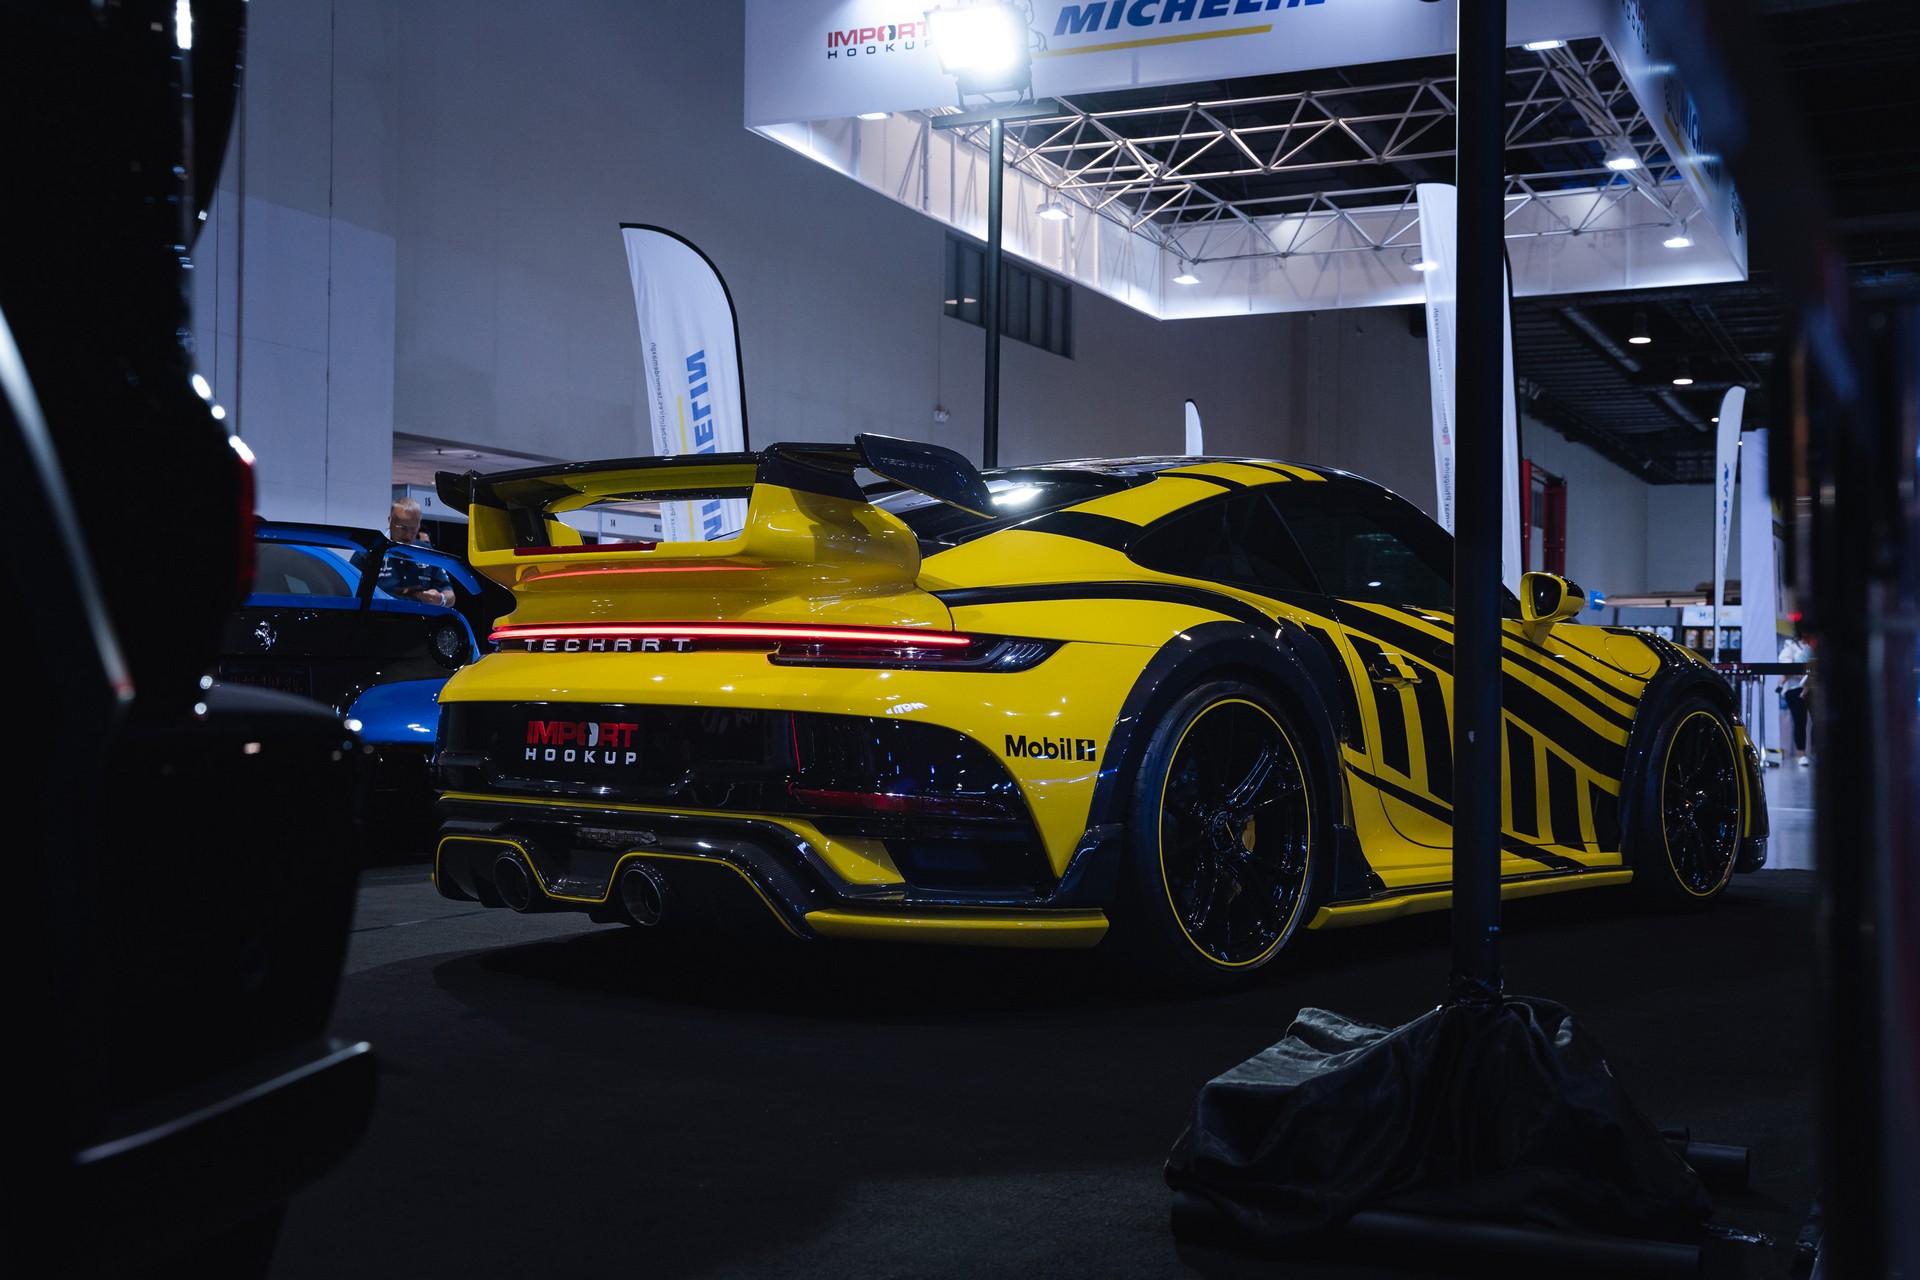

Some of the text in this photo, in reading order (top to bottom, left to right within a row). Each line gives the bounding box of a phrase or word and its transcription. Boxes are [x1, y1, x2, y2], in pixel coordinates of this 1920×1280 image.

[1053, 0, 1325, 36] MICHEL
[828, 22, 927, 48] IMPORT
[828, 40, 933, 59] HOOKUP
[524, 638, 691, 652] TECHART
[526, 720, 639, 748] IMPORT
[525, 748, 637, 765] HOOKUP
[1005, 735, 1072, 760] Mobil
